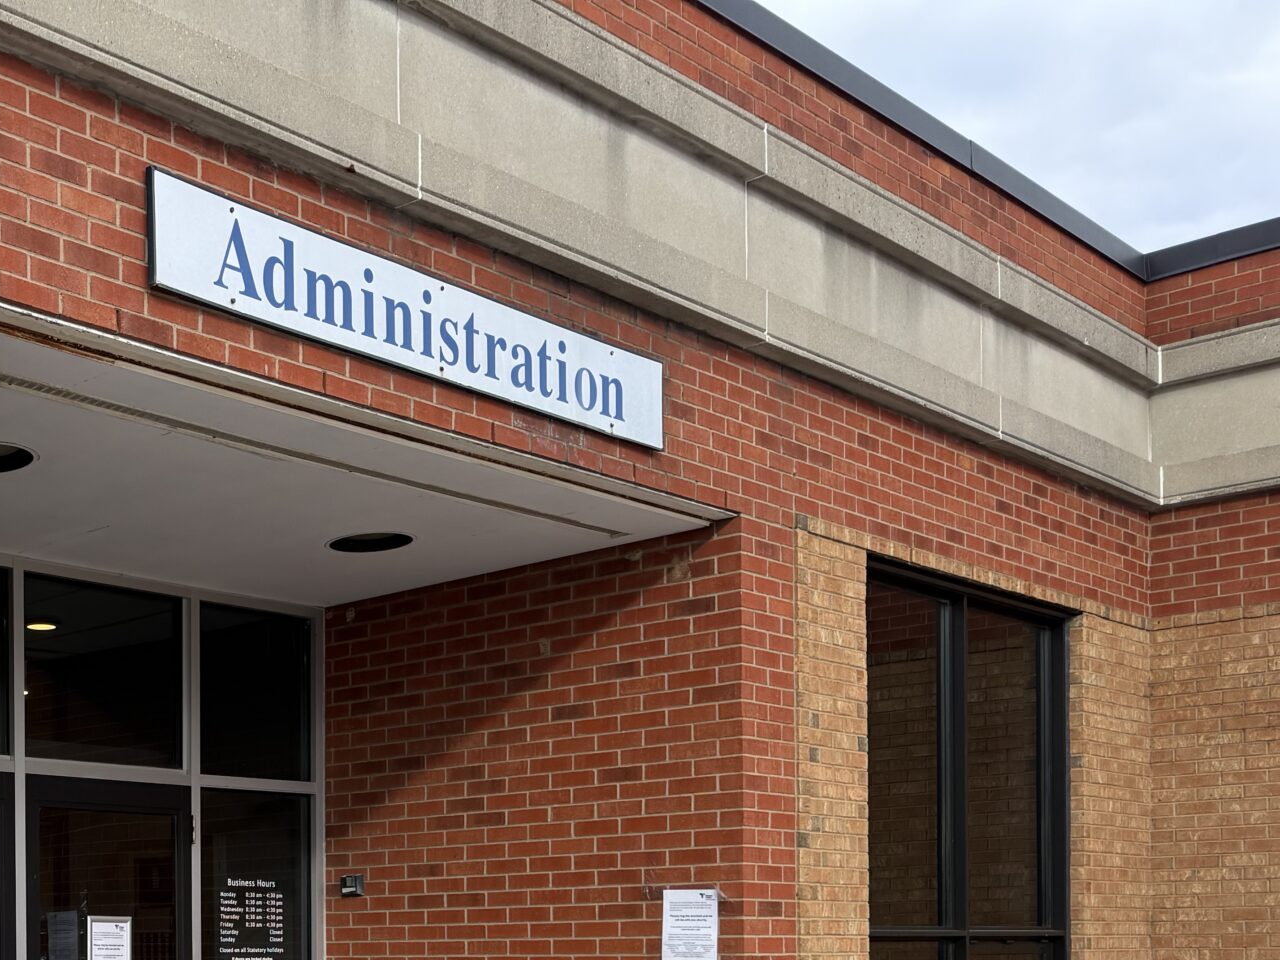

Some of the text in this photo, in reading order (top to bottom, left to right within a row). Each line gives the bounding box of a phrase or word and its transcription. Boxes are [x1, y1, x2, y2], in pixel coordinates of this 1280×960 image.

[213, 218, 626, 422] Administration
[227, 878, 276, 888] Business Hours
